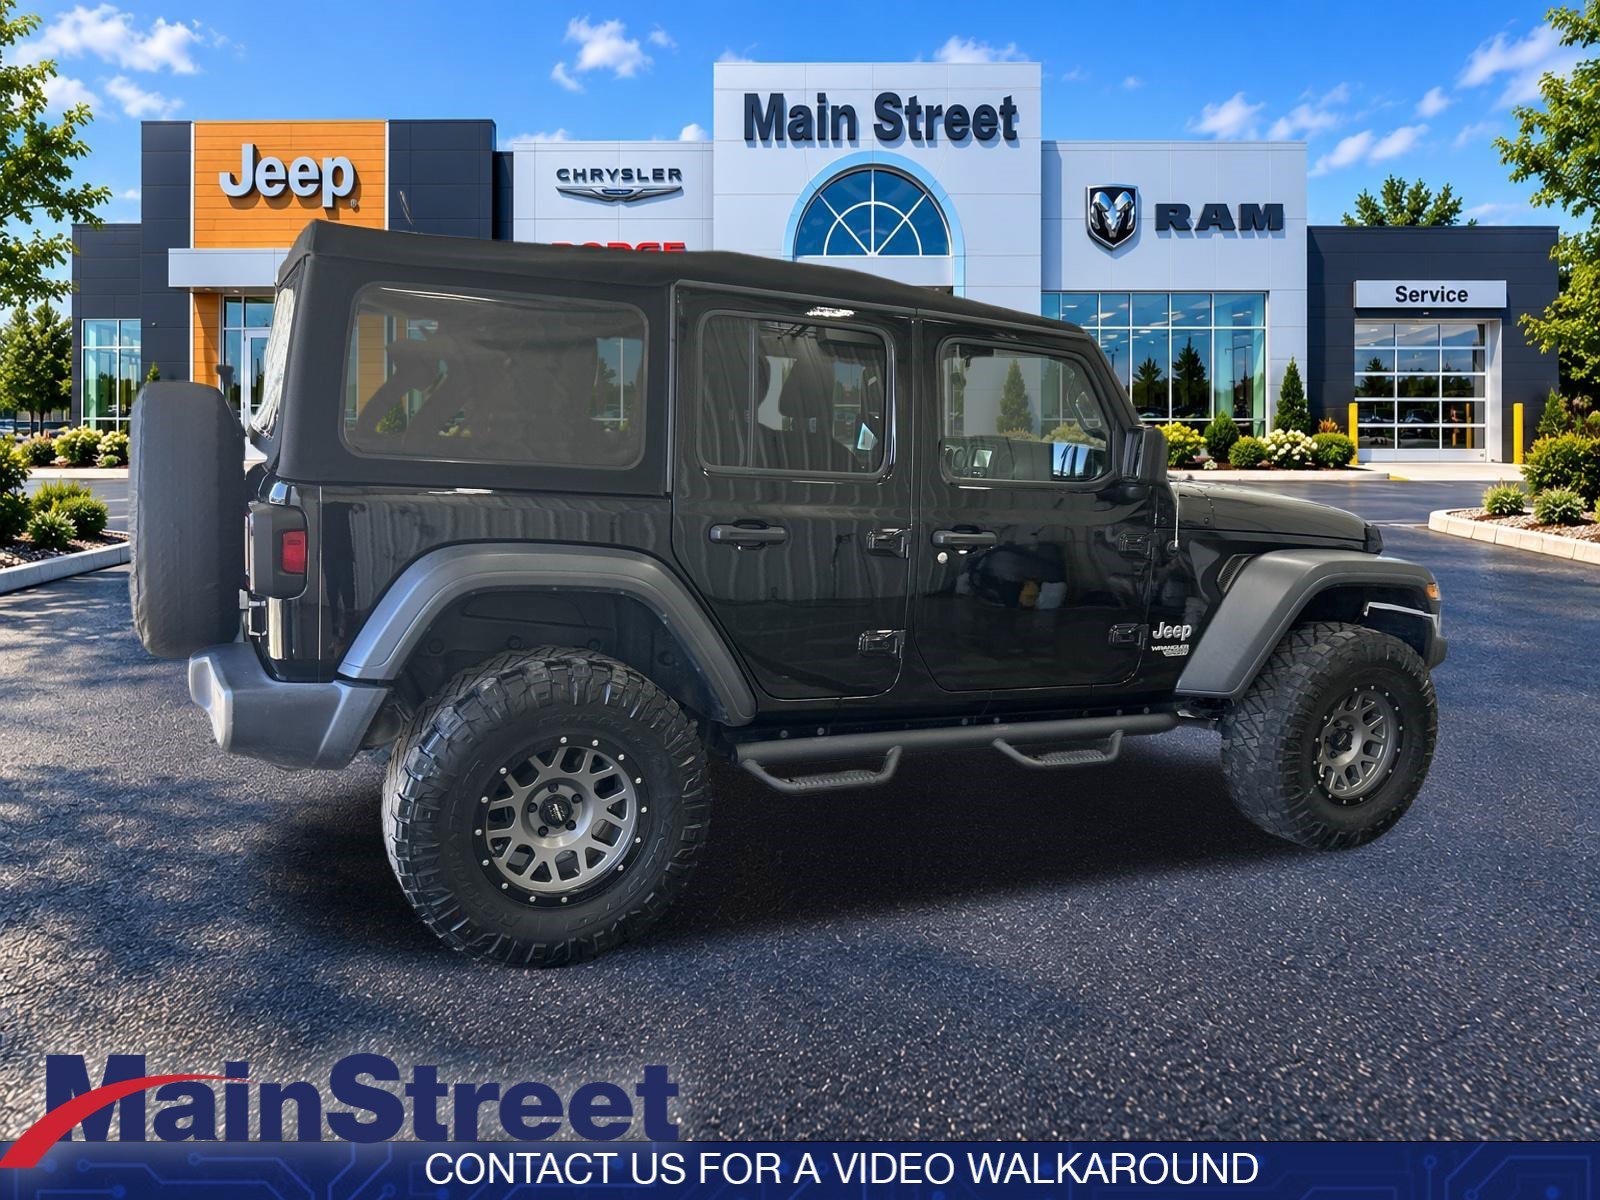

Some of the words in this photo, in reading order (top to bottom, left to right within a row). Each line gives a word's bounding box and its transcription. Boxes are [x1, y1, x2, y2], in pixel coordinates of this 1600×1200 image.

[743, 92, 857, 141] Main
[873, 91, 1018, 142] Street
[218, 143, 355, 209] Jeep
[556, 168, 683, 182] CHRYSLER
[1154, 203, 1284, 231] RAM
[1395, 285, 1468, 303] Service
[1152, 621, 1192, 641] Jeep
